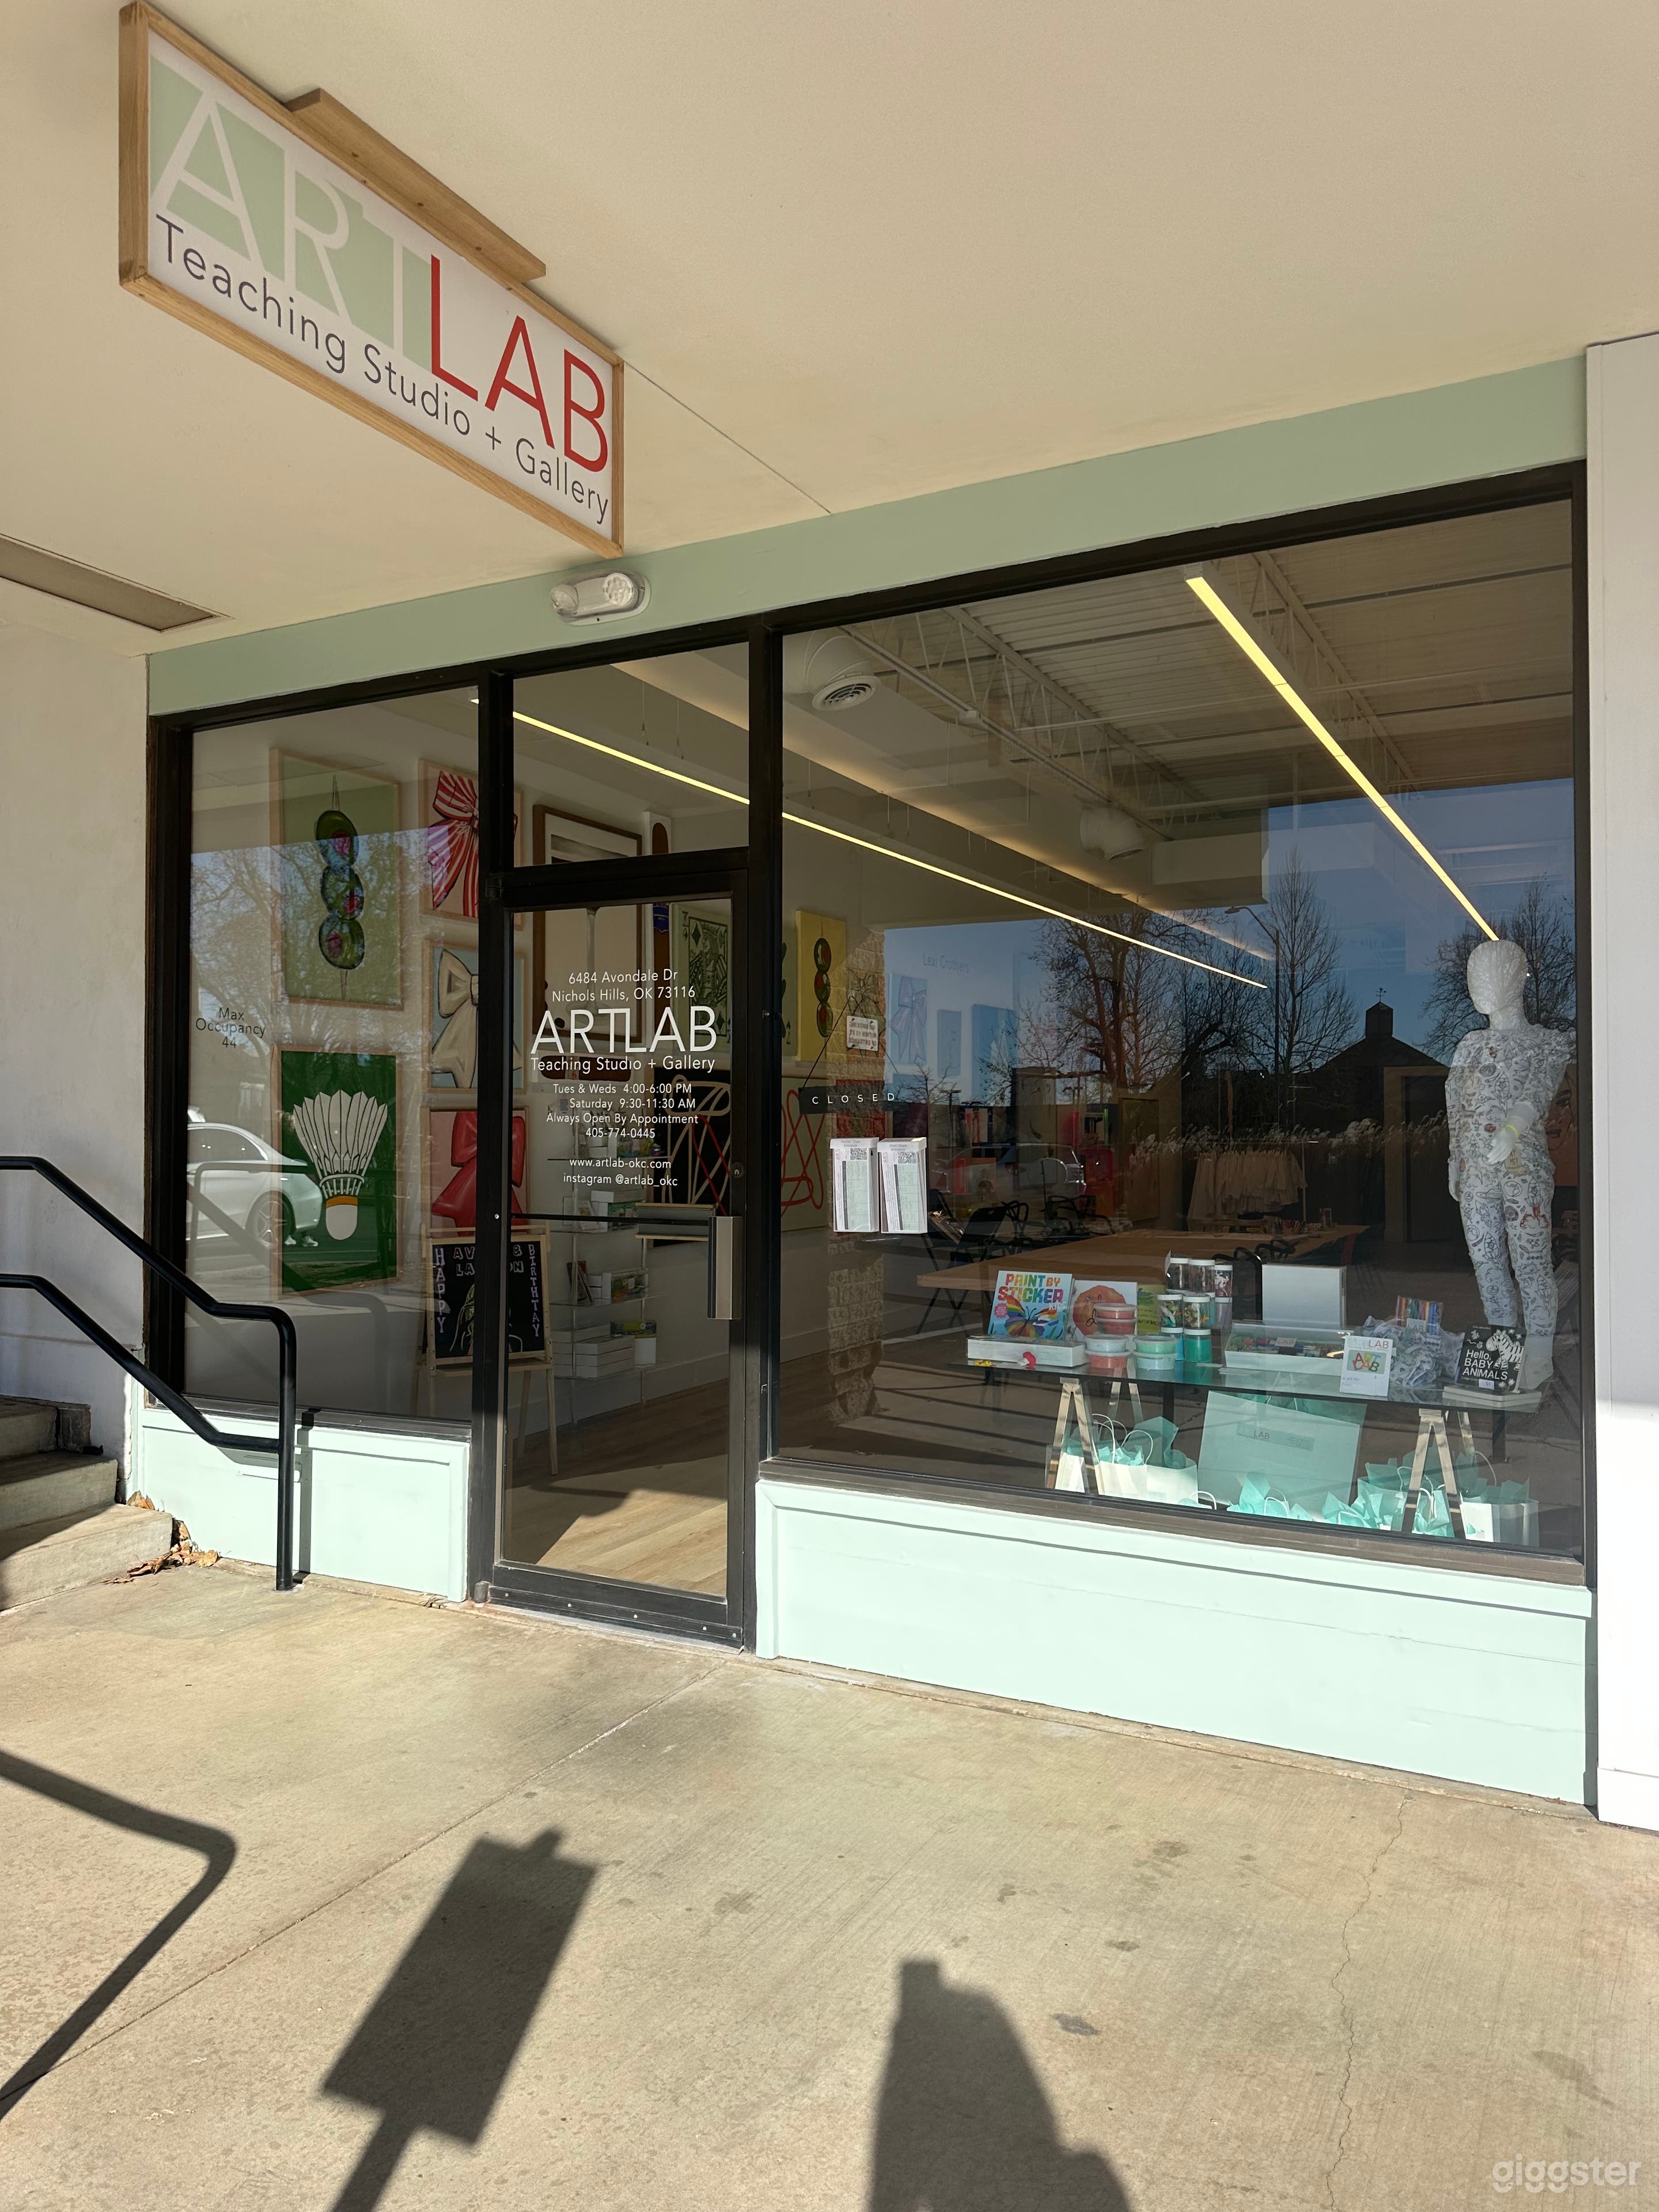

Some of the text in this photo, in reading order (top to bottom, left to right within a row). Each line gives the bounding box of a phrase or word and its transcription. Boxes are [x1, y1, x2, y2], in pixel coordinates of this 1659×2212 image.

[156, 214, 609, 525] Teaching Studio + Gallery
[569, 969, 678, 984] 6484 Avondale Dr
[552, 986, 695, 1002] Nichols Hills, OK 73116
[219, 1007, 244, 1021] Max
[196, 1018, 266, 1038] Occupancy
[531, 1006, 717, 1054] ARTLAB
[222, 1037, 237, 1048] 44
[531, 1055, 715, 1074] Teaching Studio + Gallery
[553, 1084, 691, 1094] Tues & Weds 4:00-6:00 PM
[570, 1099, 696, 1111] Saturday 9:30-11:30 AM
[812, 1093, 895, 1104] CLOSED
[546, 1113, 699, 1126] Always Open By Appointment
[585, 1128, 655, 1138] 405-774-0445
[569, 1157, 672, 1169] www.artlab-okc.com
[563, 1173, 677, 1187] instagram @artlab_okc
[1005, 1273, 1060, 1287] PAINT BY
[435, 1248, 446, 1333] HAPPY
[998, 1286, 1063, 1304] STICKER
[1369, 1339, 1389, 1349] LAB
[1467, 1350, 1491, 1361] Hello,
[1464, 1358, 1494, 1369] BABY
[1463, 1368, 1508, 1380] ANIMALS
[1253, 1429, 1270, 1440] LAB
